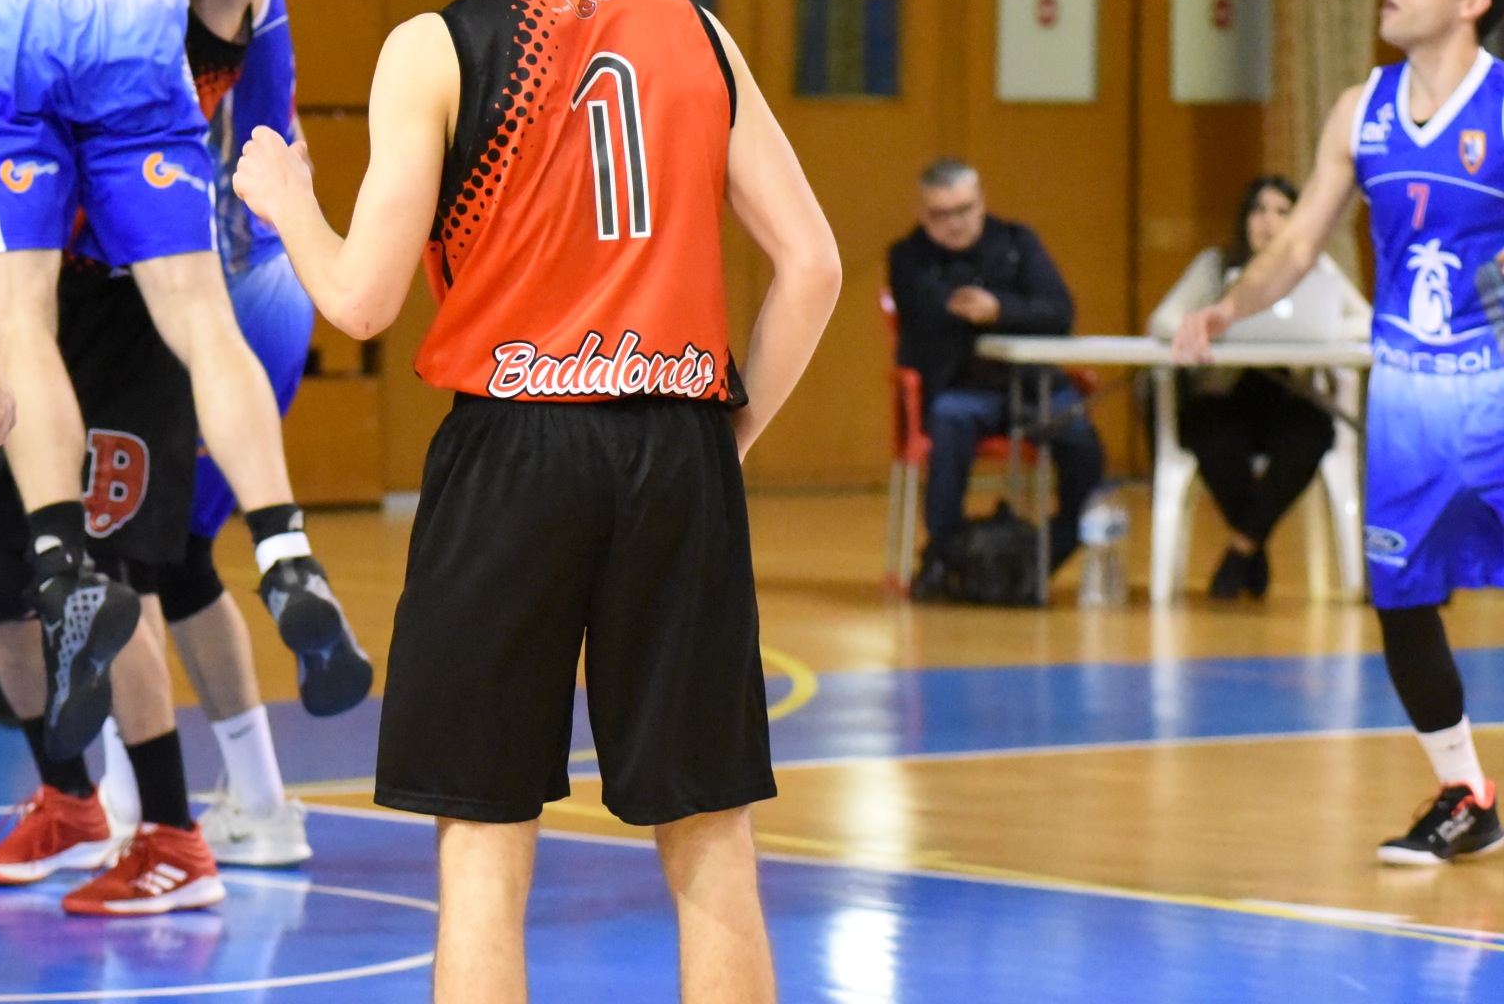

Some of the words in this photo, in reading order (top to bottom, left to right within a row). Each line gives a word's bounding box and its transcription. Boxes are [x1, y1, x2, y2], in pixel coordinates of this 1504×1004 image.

[570, 52, 652, 241] 1
[1406, 183, 1430, 231] 7
[489, 330, 715, 398] Badalonès
